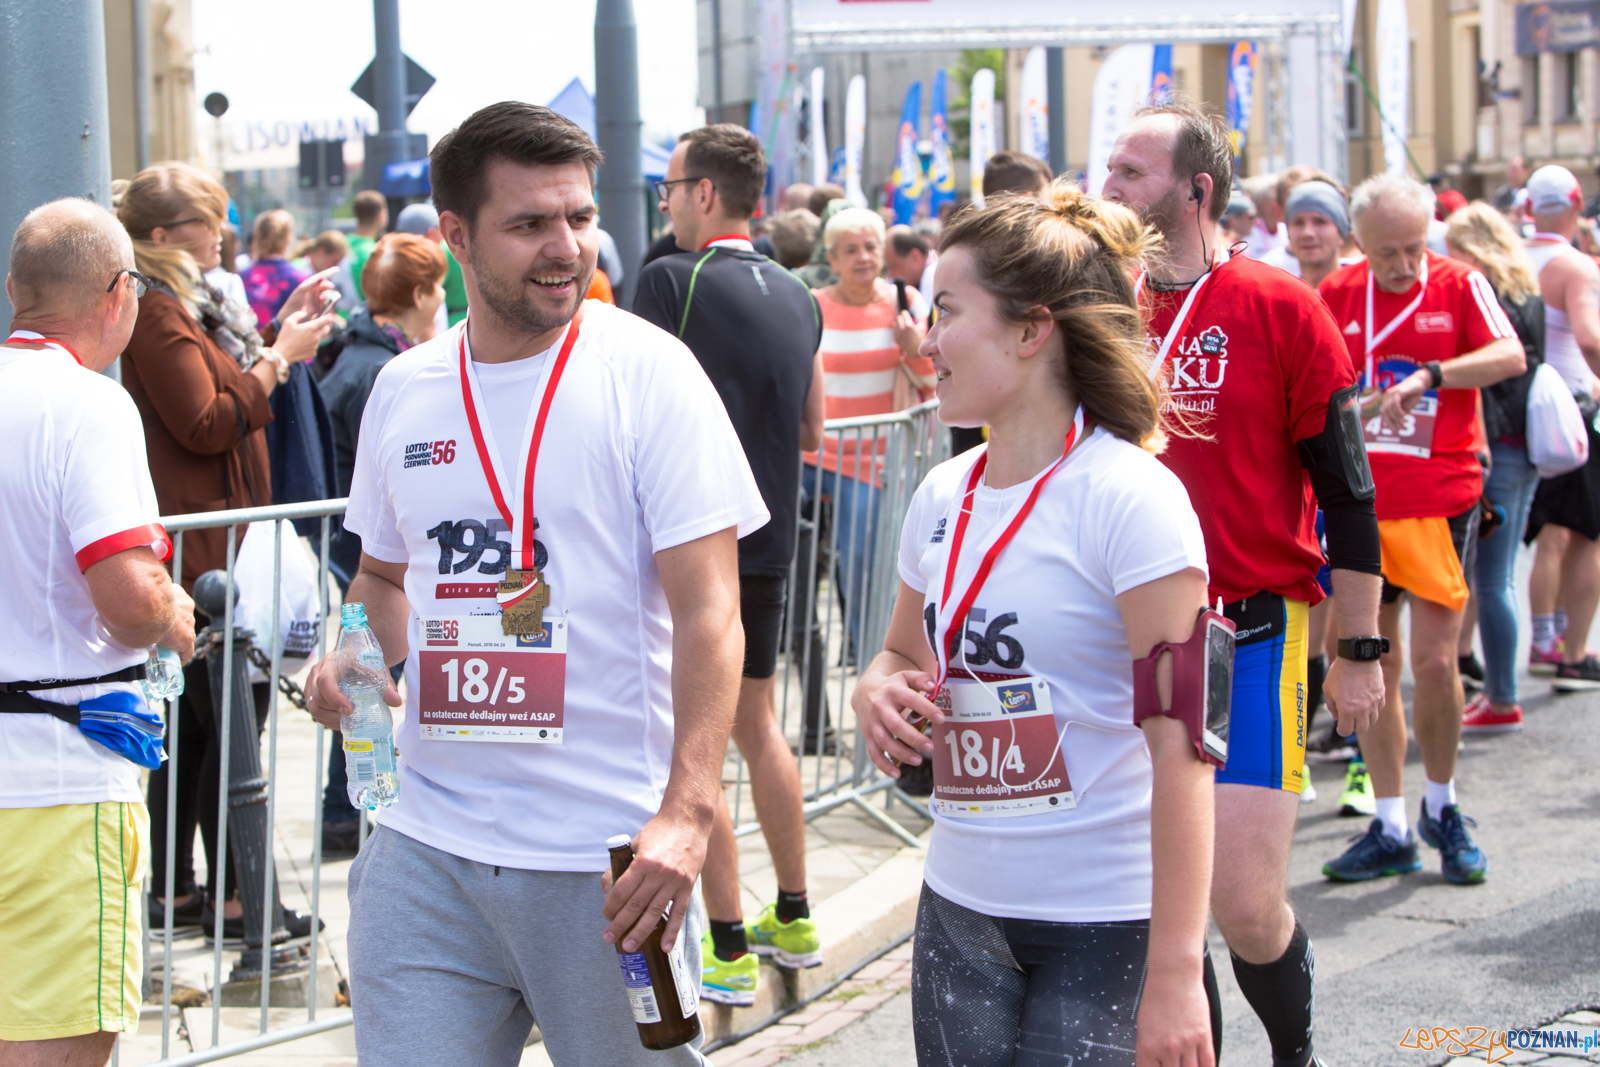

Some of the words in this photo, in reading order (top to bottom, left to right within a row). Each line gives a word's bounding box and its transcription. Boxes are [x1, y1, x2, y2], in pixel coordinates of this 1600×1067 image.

[405, 442, 428, 454] LOTTO
[404, 451, 432, 461] POZNAŃSKI
[403, 458, 431, 469] CZERWIEC
[500, 580, 523, 590] POZNAŃ
[441, 658, 526, 706] 18/5
[1007, 693, 1026, 706] LOTTO
[423, 710, 431, 718] na
[432, 710, 468, 719] ostateczne
[469, 710, 508, 722] dedlajny
[509, 711, 528, 721] weź
[530, 712, 556, 721] ASAP
[1296, 682, 1304, 747] DACHSER
[944, 729, 1025, 779] 18/4
[943, 785, 975, 794] ostateczne
[1035, 778, 1061, 790] ASAP
